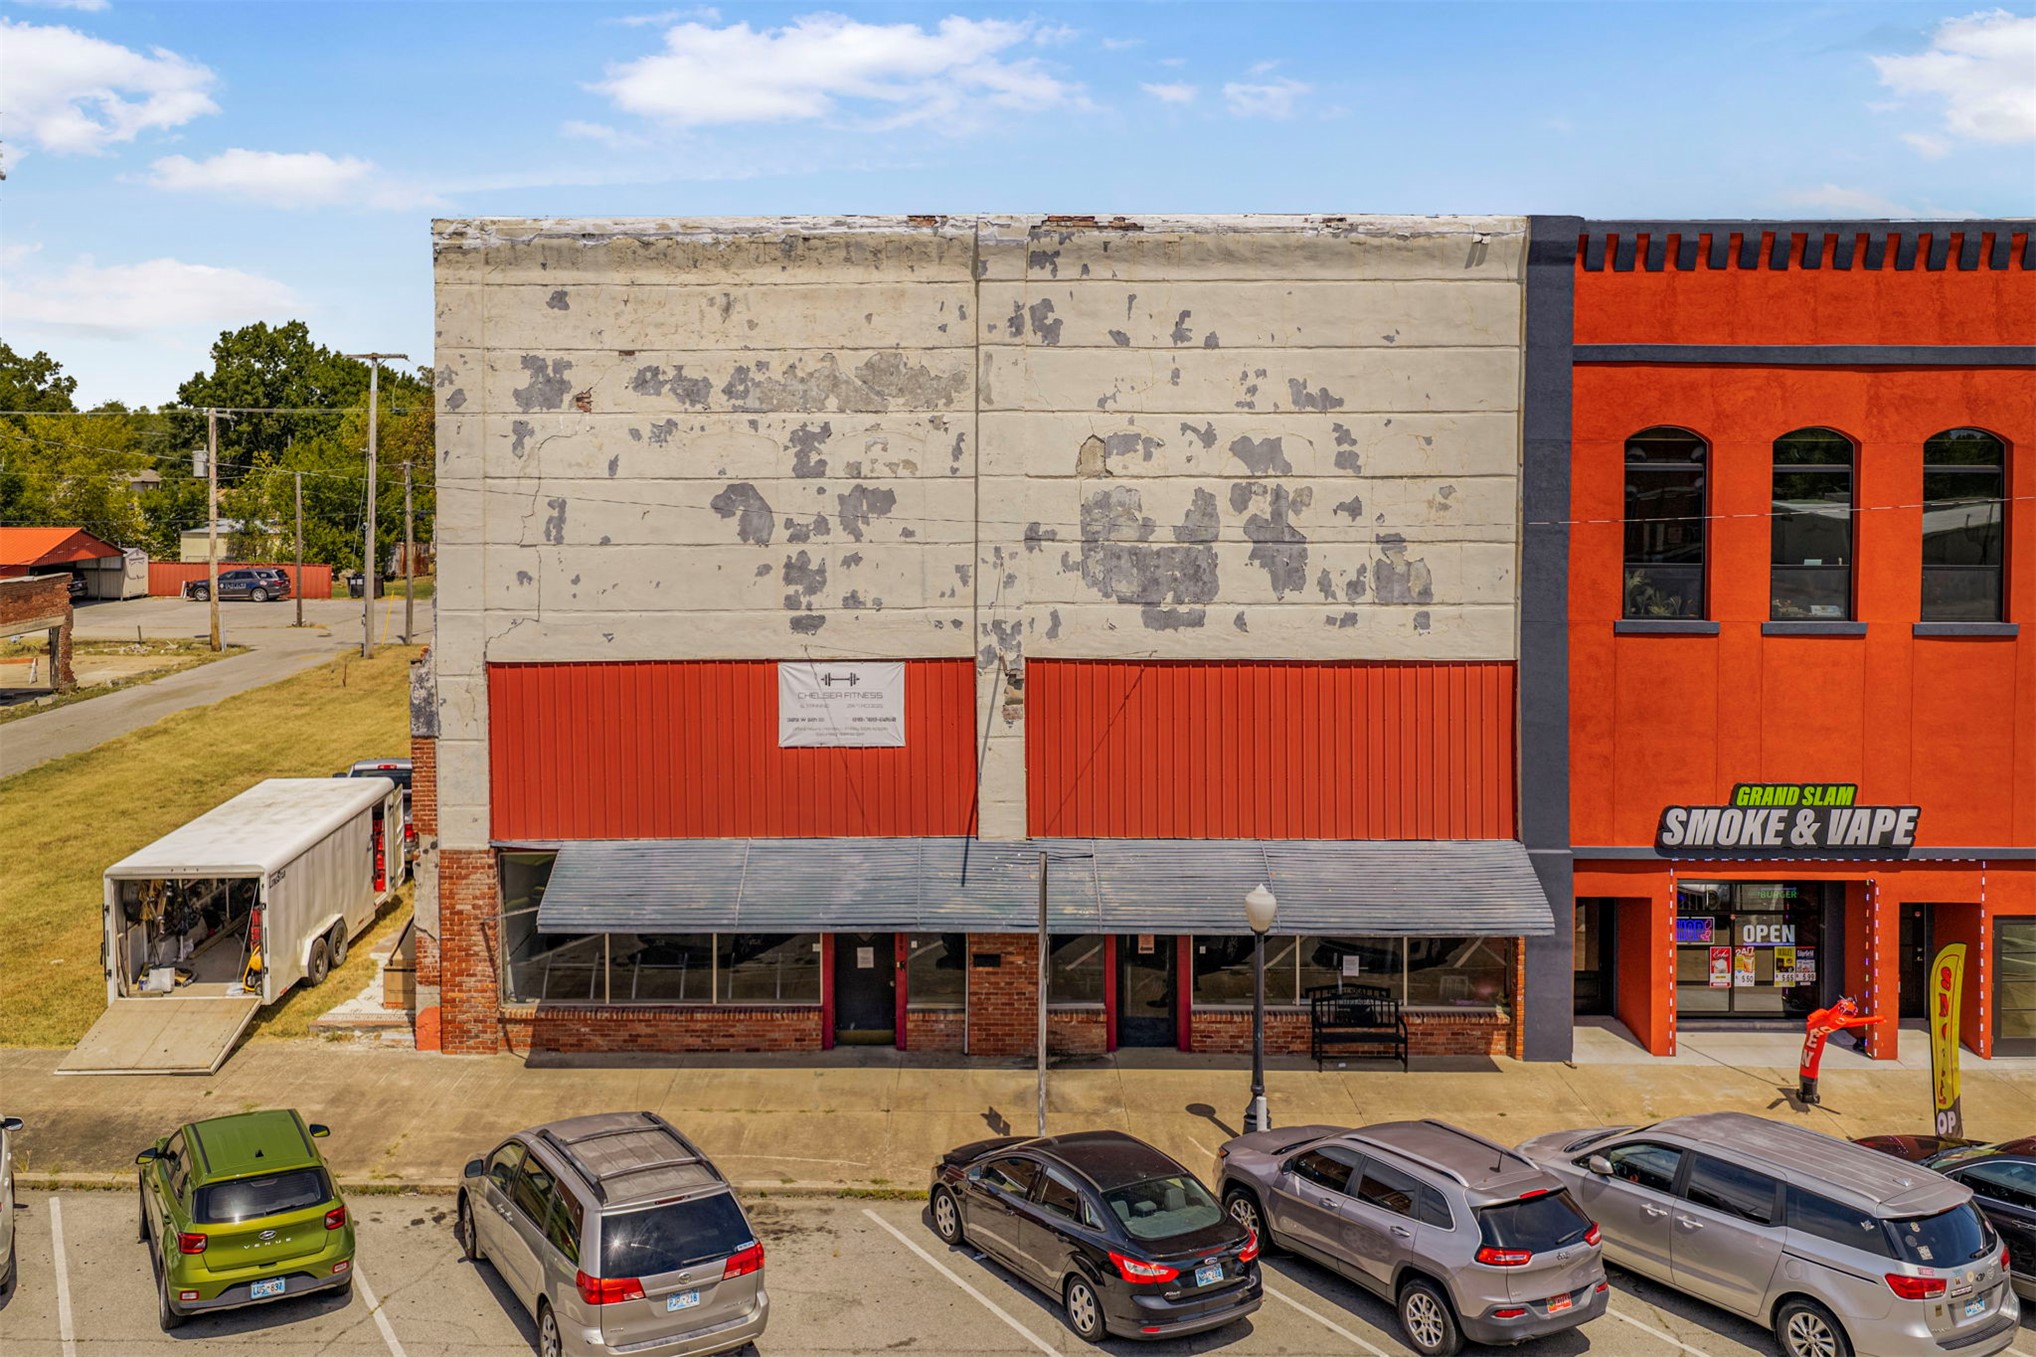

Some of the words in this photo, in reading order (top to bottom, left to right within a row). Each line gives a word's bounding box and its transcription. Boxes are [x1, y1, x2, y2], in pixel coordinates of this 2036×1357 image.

[797, 692, 842, 700] CHELSEA
[844, 692, 883, 700] FITNESS
[1737, 787, 1799, 806] GRAND
[1802, 787, 1854, 806] SLAM
[1662, 808, 1789, 846] SMOKE
[1790, 808, 1821, 846] &
[1826, 808, 1919, 846] VAPE
[1743, 924, 1796, 943] OPEN
[244, 1238, 291, 1249] VENUE
